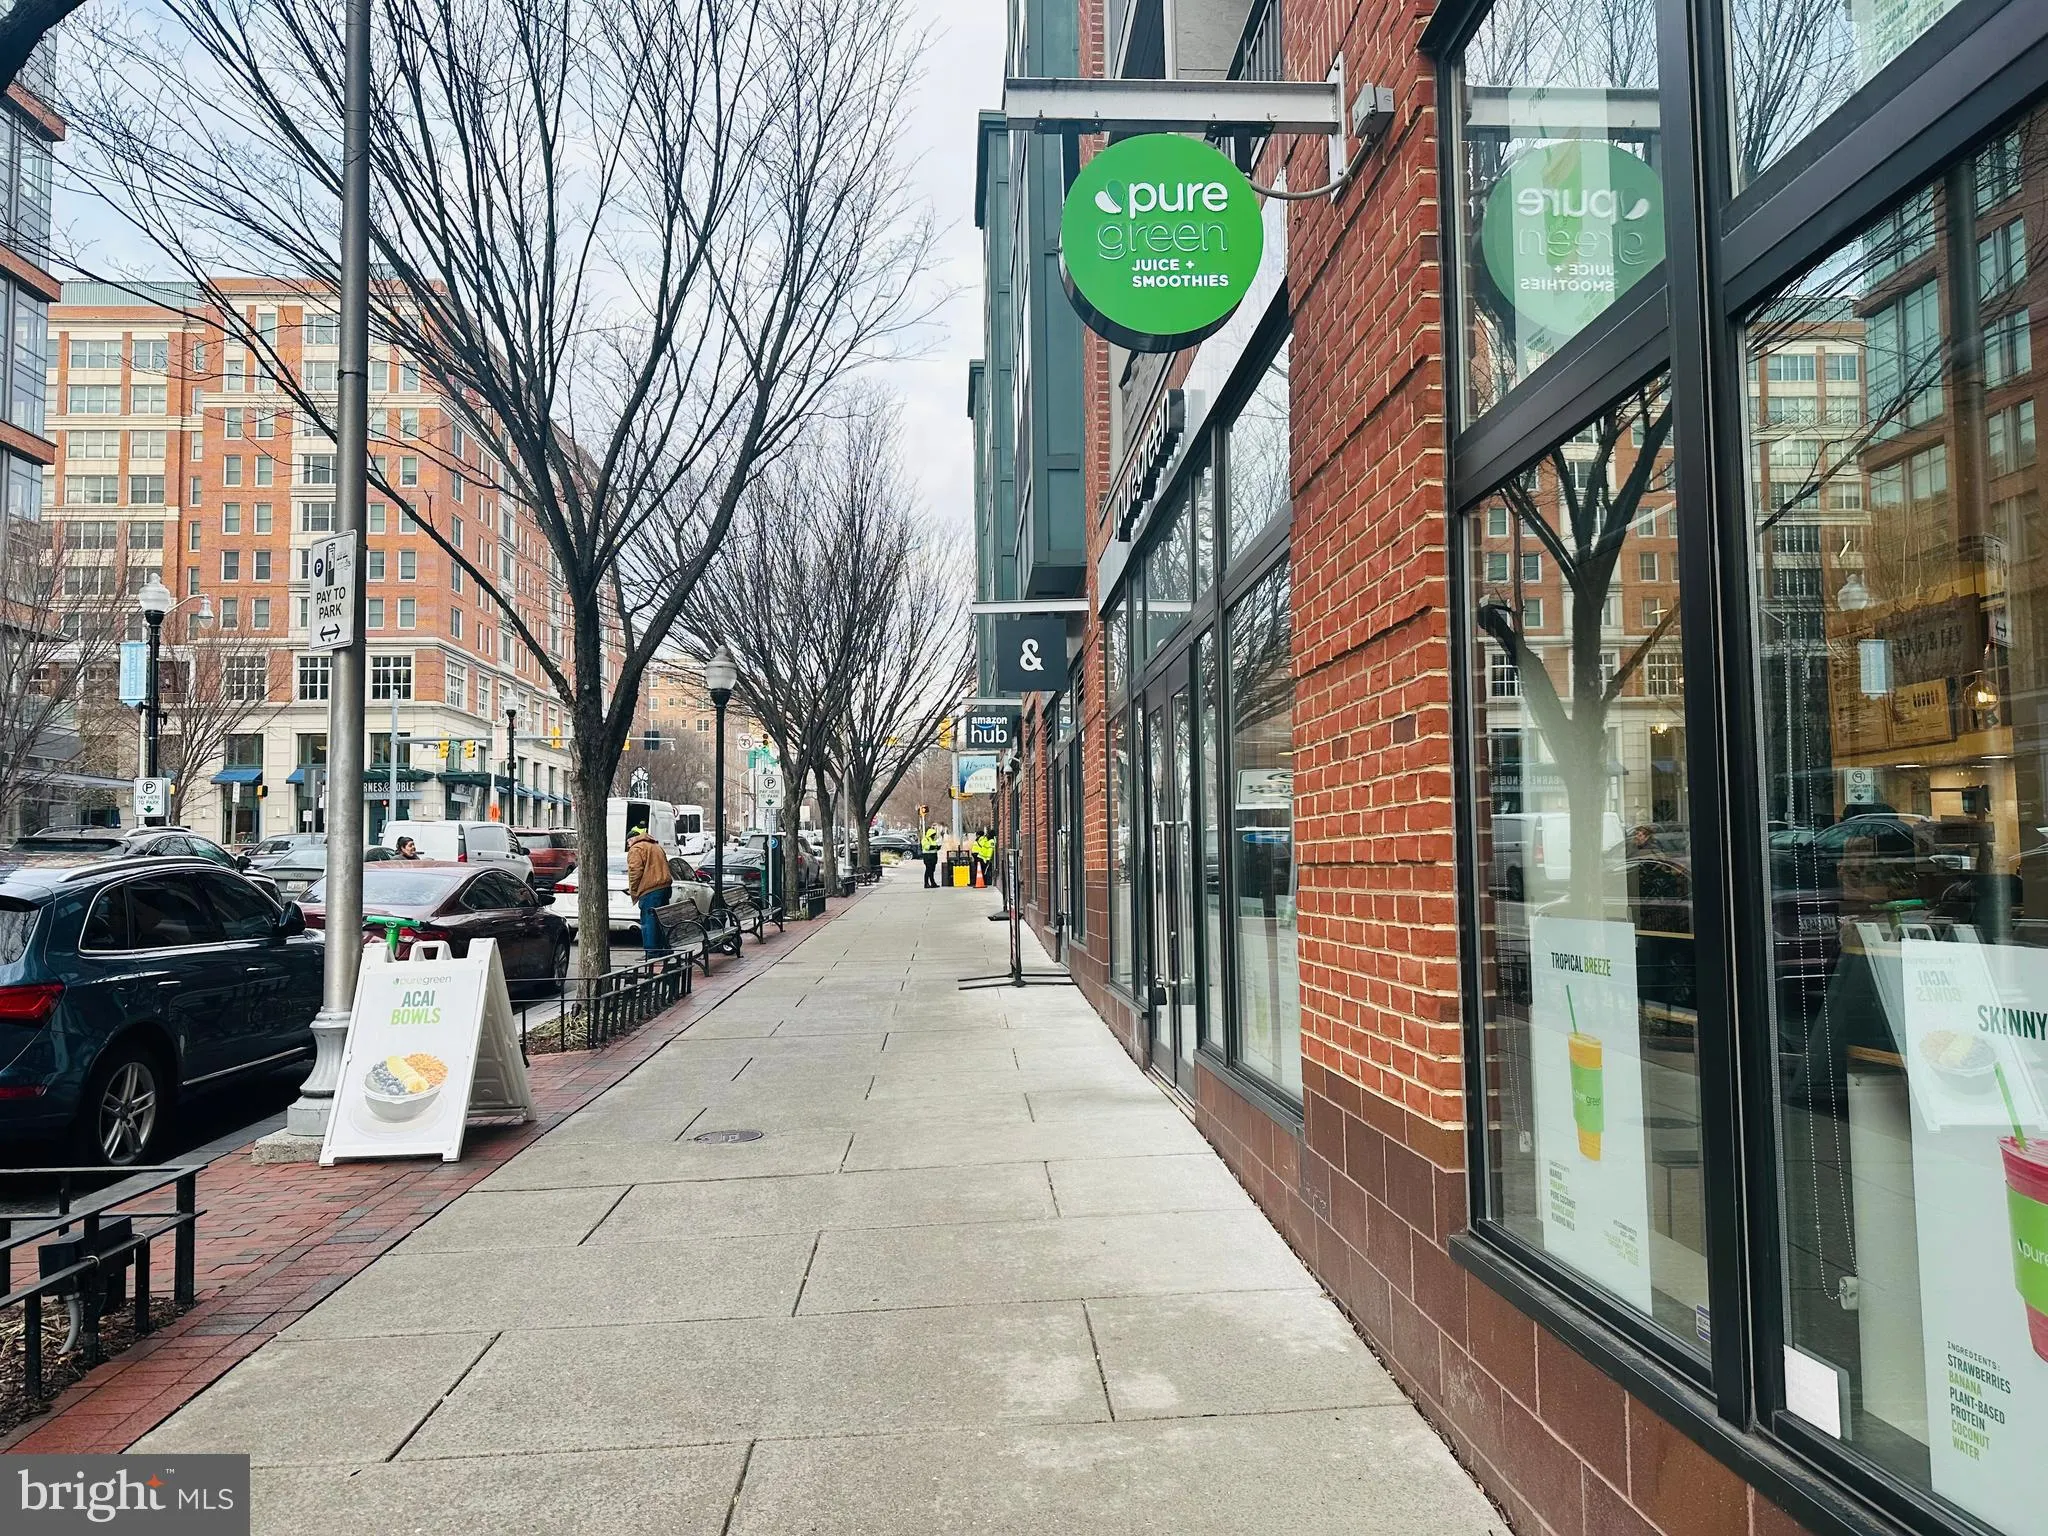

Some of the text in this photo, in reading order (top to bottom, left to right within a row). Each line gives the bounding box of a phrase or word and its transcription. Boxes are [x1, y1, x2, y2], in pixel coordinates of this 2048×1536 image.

[1129, 182, 1228, 220] pure
[1098, 220, 1229, 260] green
[1132, 259, 1180, 271] JUICE
[1132, 274, 1229, 288] SMOOTHIES
[316, 586, 346, 605] PAY TO
[319, 602, 342, 620] PARK
[1020, 638, 1045, 671] &
[971, 716, 1008, 725] amazon
[971, 725, 1008, 744] hub
[363, 782, 383, 793] RNES
[396, 781, 415, 792] OBLE
[1551, 952, 1611, 977] TROPICAL BREEZE
[401, 990, 436, 1007] ACAI
[391, 1008, 441, 1025] BOWLS
[1978, 1004, 2048, 1041] SKINNY
[1947, 1341, 2000, 1371] INGREDIENTS:
[1947, 1353, 2011, 1394] STRAWBERRIES
[1949, 1370, 1982, 1397] BANANA
[1950, 1386, 2005, 1424] PLANT-BASED
[1951, 1403, 1985, 1431] PROTEIN
[1952, 1420, 1990, 1450] COCONUT
[1953, 1436, 1980, 1460] WATER
